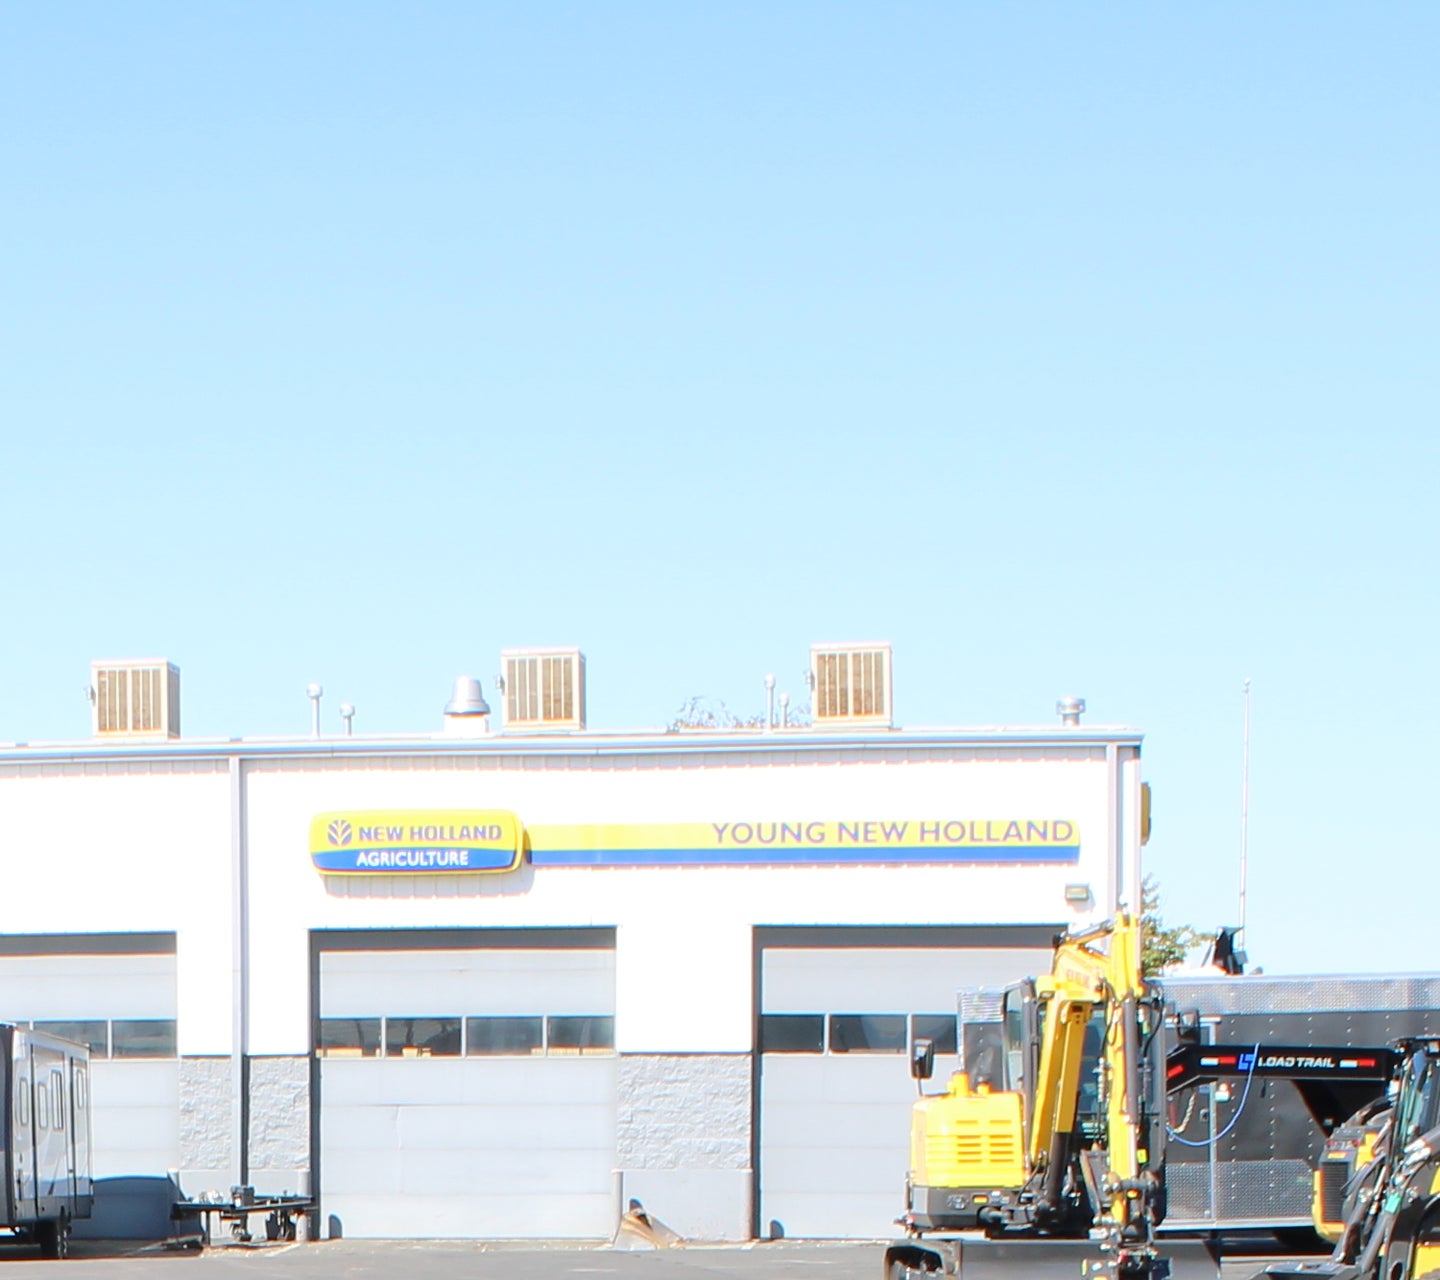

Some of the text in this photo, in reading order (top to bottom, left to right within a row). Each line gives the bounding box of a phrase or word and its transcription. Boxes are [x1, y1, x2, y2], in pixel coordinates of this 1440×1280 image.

[358, 825, 503, 841] NEW HOLLAND
[713, 820, 1074, 844] YOUNG NEW HOLLAND
[356, 850, 469, 867] AGRICULTURE
[1296, 1057, 1336, 1068] TRAIL
